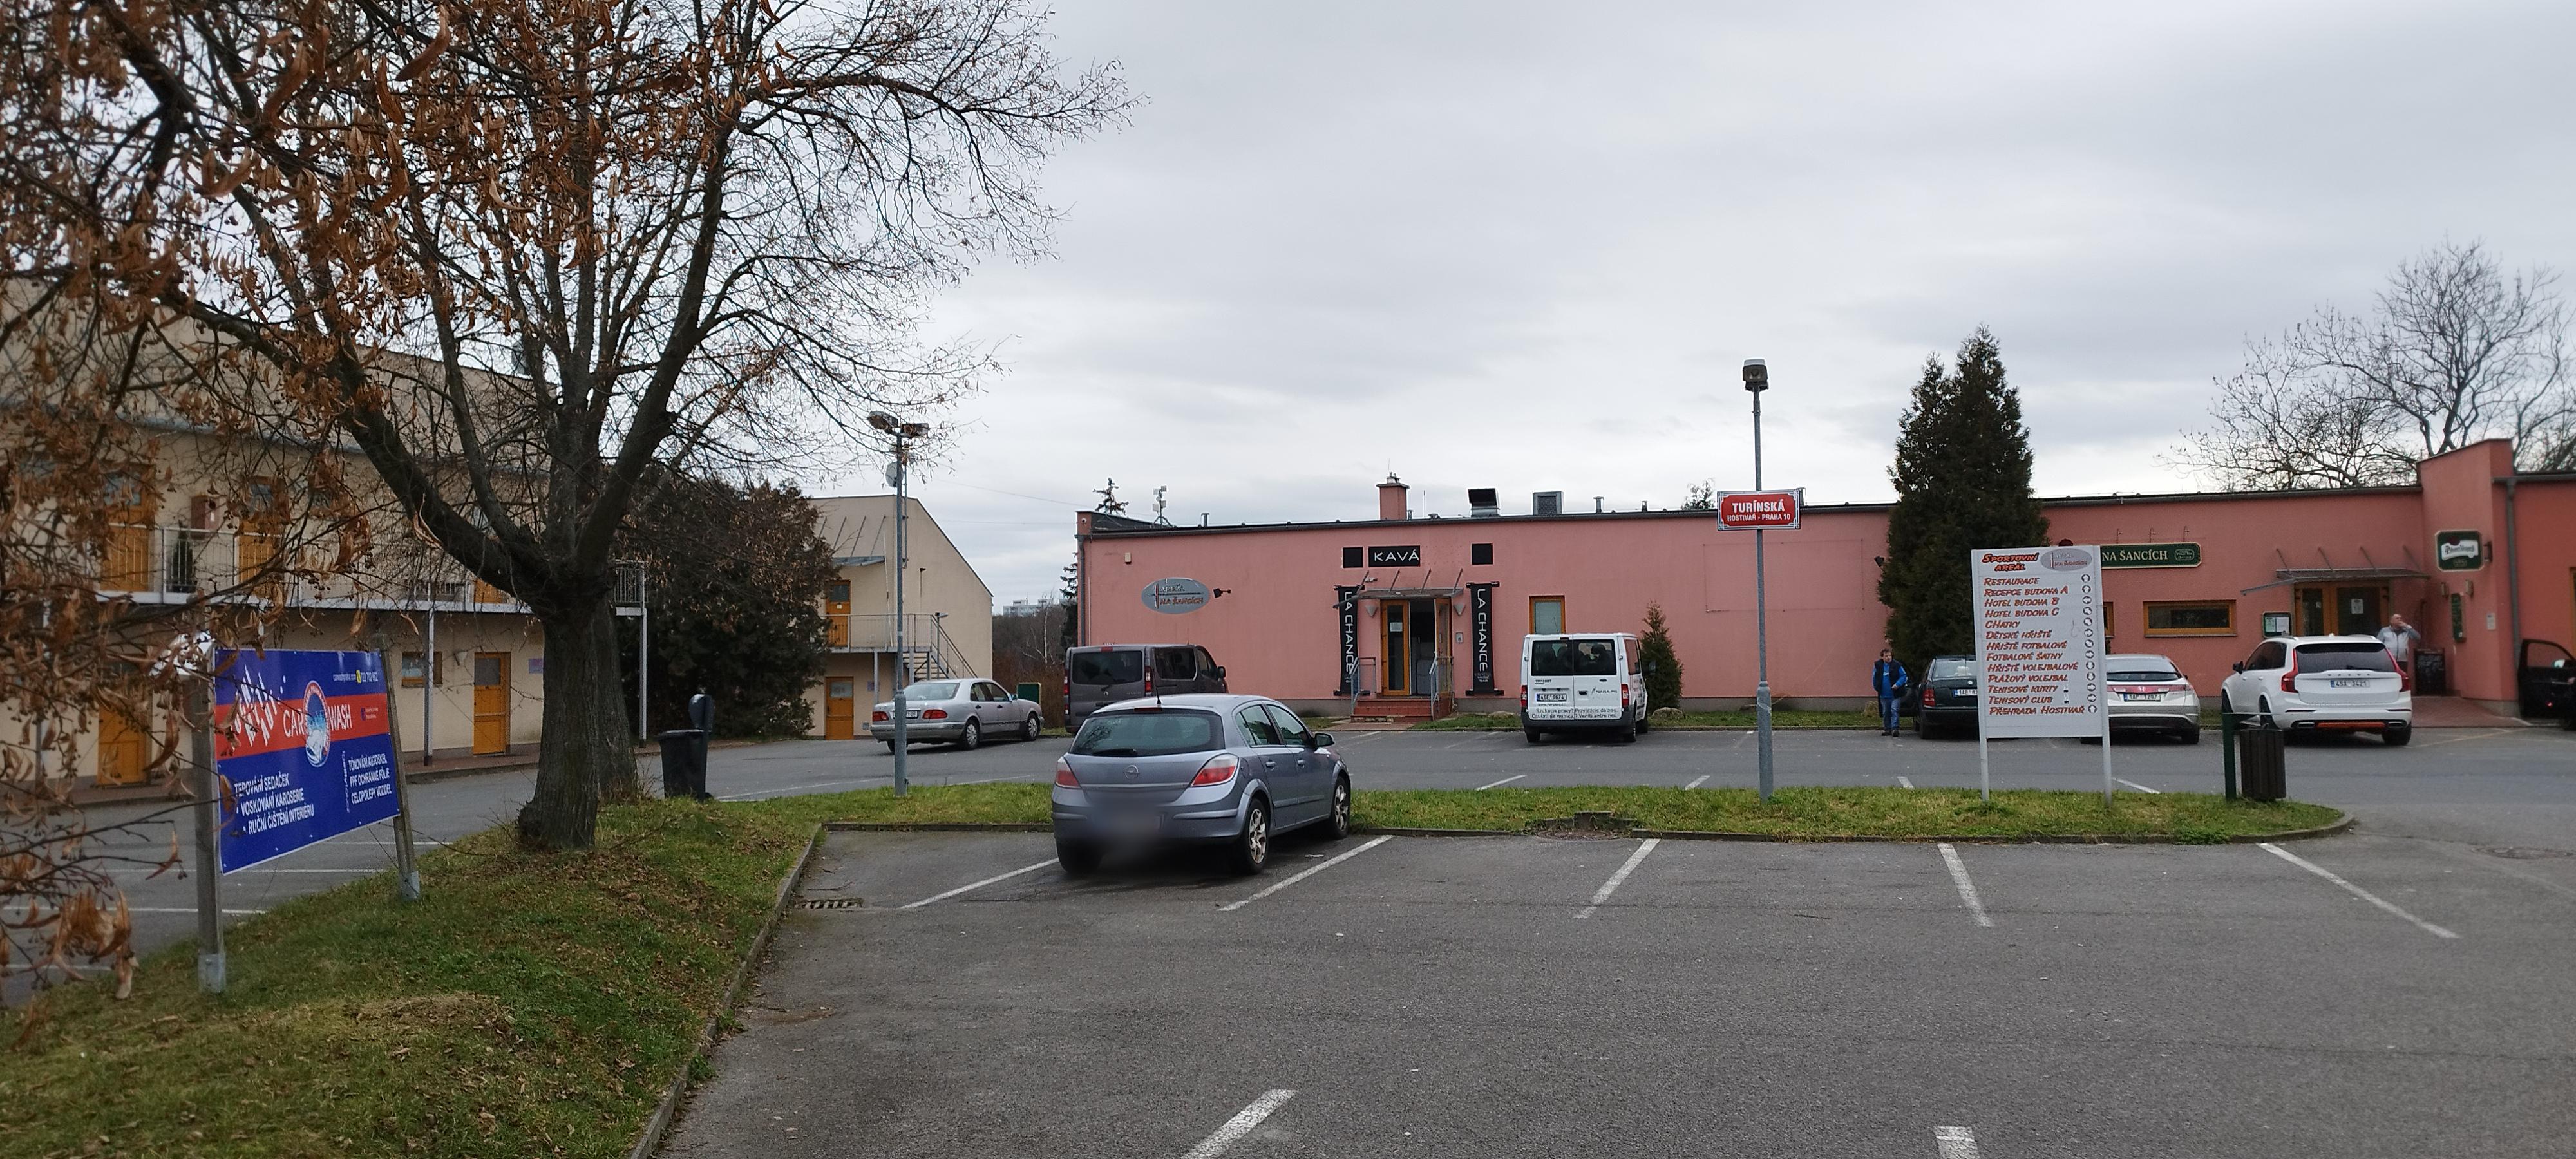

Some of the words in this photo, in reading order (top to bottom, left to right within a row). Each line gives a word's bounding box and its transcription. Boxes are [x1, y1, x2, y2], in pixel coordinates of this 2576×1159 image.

[1732, 498, 1785, 513] TURÍNSKÁ
[1374, 549, 1419, 561] KAVÁ
[2102, 552, 2117, 561] NA
[2119, 549, 2168, 561] ŠANCÍCH
[2060, 586, 2069, 594] A
[1477, 589, 1486, 608] LA
[2050, 597, 2060, 605] B
[2052, 608, 2060, 616] C
[1478, 613, 1488, 672] CHANCE
[283, 708, 305, 738] CAR
[328, 704, 353, 731] WASH
[234, 775, 263, 797] TEPOVÁNÍ
[264, 771, 290, 791] SEDAČEK
[350, 775, 358, 788] PPF
[377, 783, 392, 798] VOZIDEL
[241, 791, 274, 816] VOSKOVÁNÍ
[275, 787, 305, 807] KAROSERIE
[248, 813, 267, 834] RUČNÍ
[267, 807, 289, 829] ČIŠTĚNÍ
[289, 802, 314, 822] INTERIÉRU
